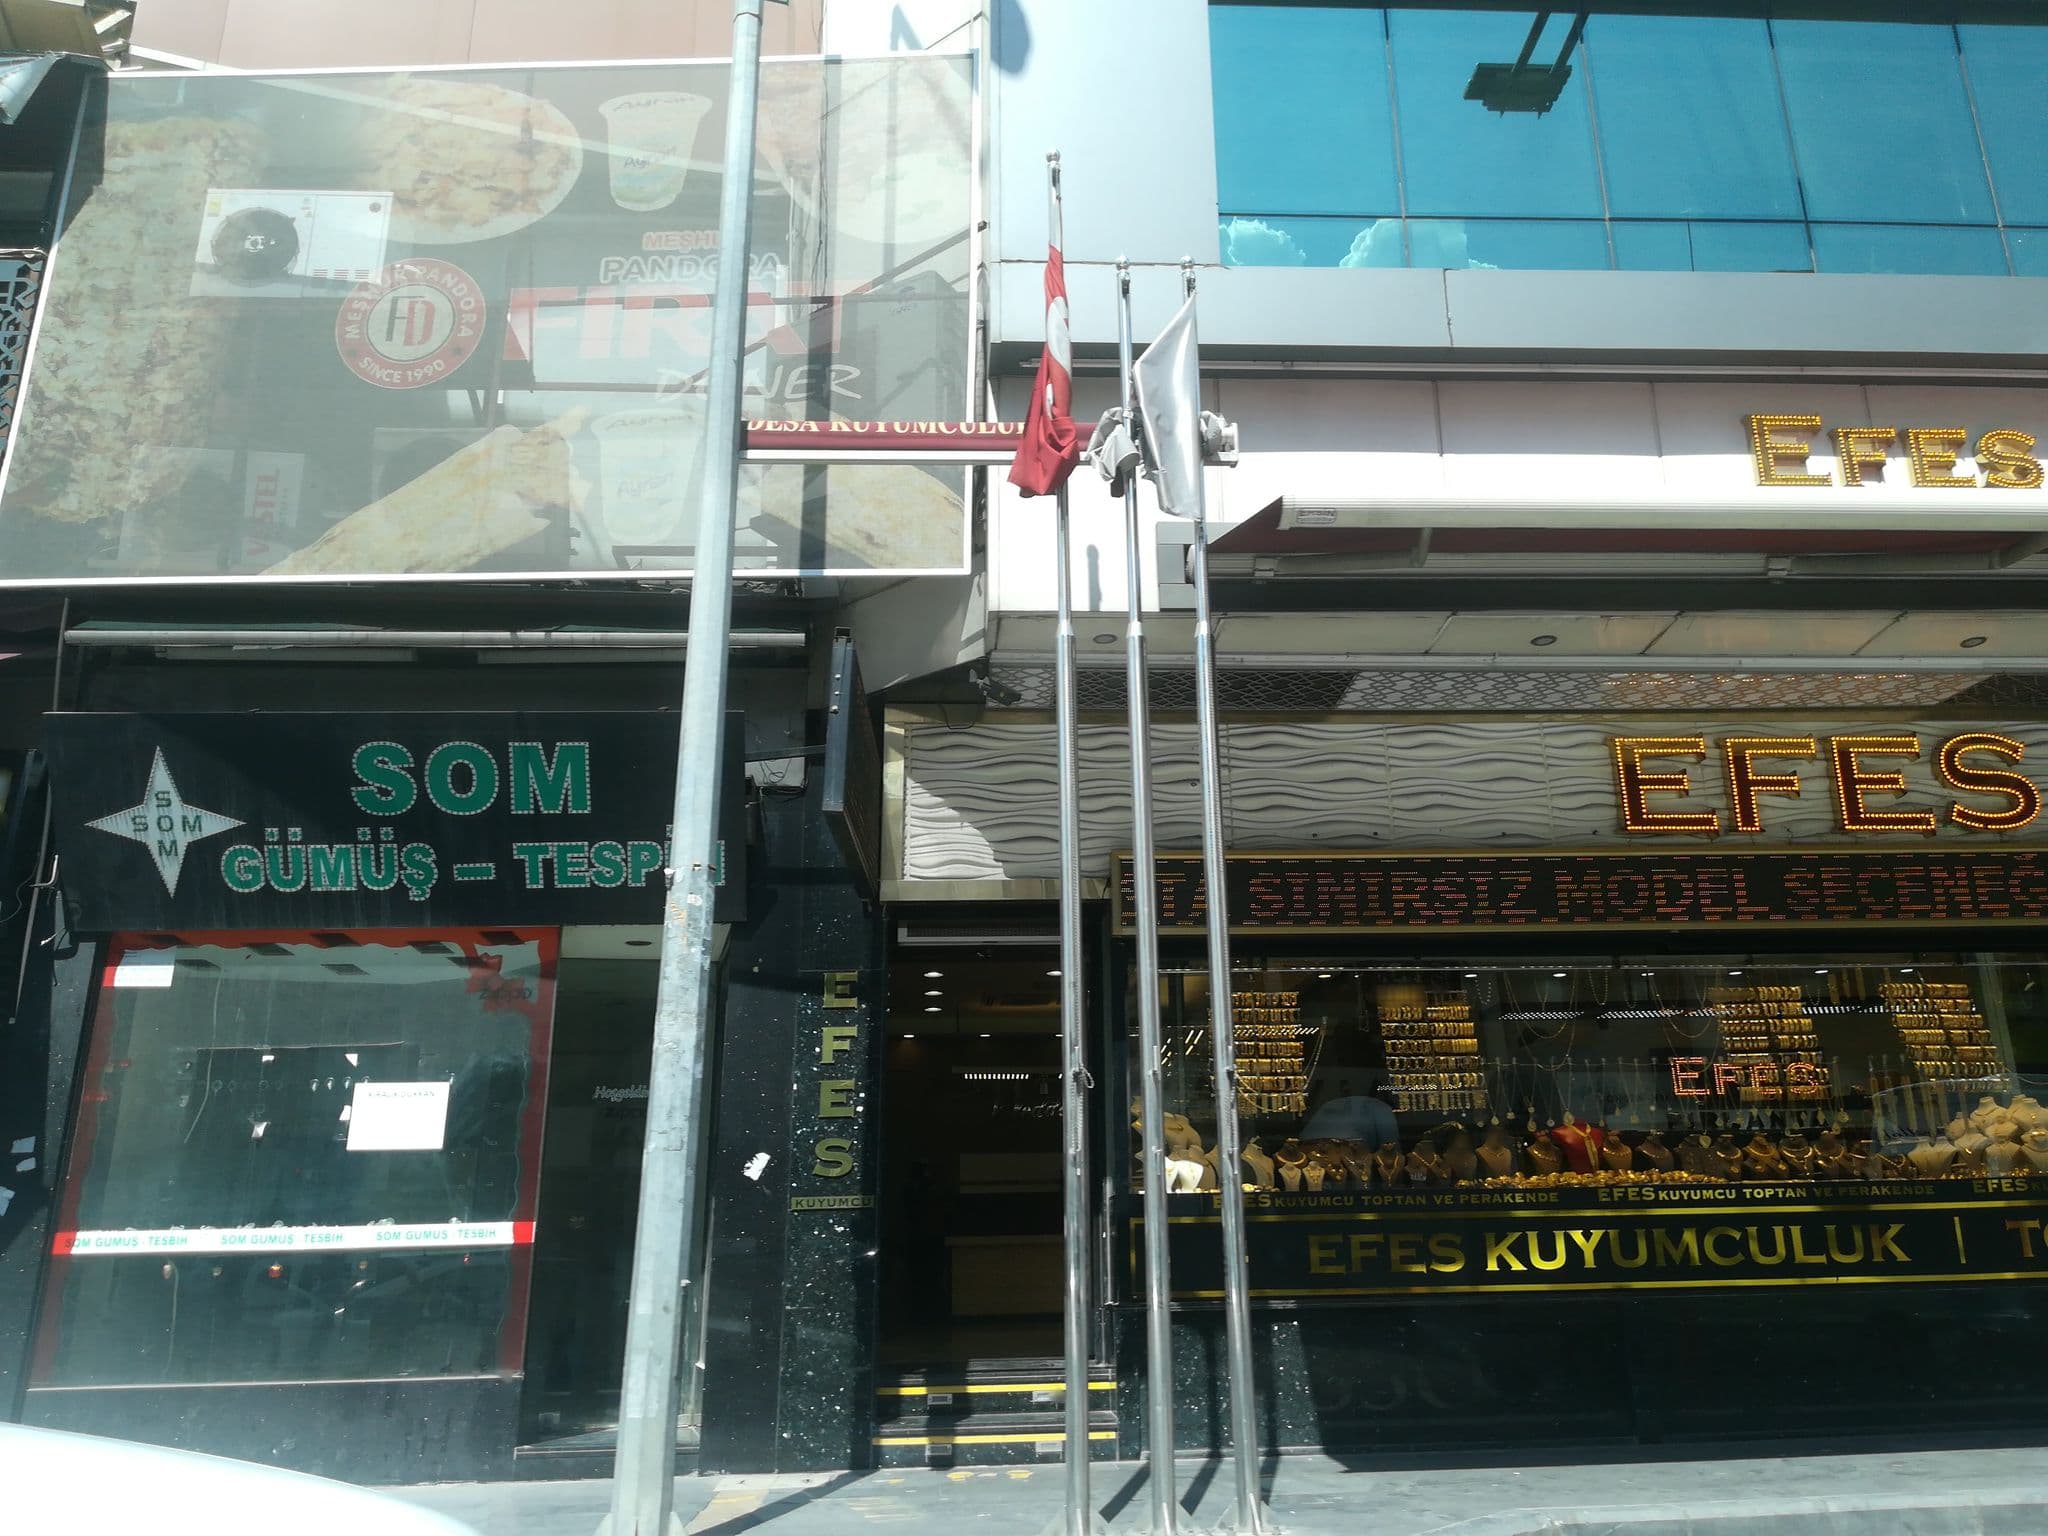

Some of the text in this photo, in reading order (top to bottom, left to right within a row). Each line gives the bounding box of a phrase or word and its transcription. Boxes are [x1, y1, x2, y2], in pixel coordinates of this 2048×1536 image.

[642, 230, 720, 253] MEŞH
[359, 356, 446, 383] SINCE 1990
[655, 364, 863, 402] DNER
[1749, 414, 2046, 488] EFES
[350, 740, 593, 816] SOM
[1611, 732, 2042, 835] EFES
[220, 826, 439, 901] GÜMÜŞ
[512, 824, 726, 889] TESP
[1552, 867, 1770, 914] MODEL
[812, 970, 858, 1178] EFES
[1669, 1056, 1820, 1097] EFES
[795, 1197, 872, 1209] KUYUMCU
[1275, 1196, 1353, 1208] KUYUMCU
[1361, 1194, 1426, 1206] TOPTAN
[1432, 1193, 1454, 1205] VE
[1460, 1191, 1559, 1204] PERAKENDE
[1599, 1184, 1936, 1201] EFES KUYUMCU TOPTAN VE PERAKENDE
[1972, 1178, 2028, 1193] EFES
[221, 1234, 246, 1245] SOM
[376, 1231, 401, 1241] SOM
[1308, 1222, 1912, 1275] EFES KUYUMCULUK
[2005, 1218, 2048, 1258] T
